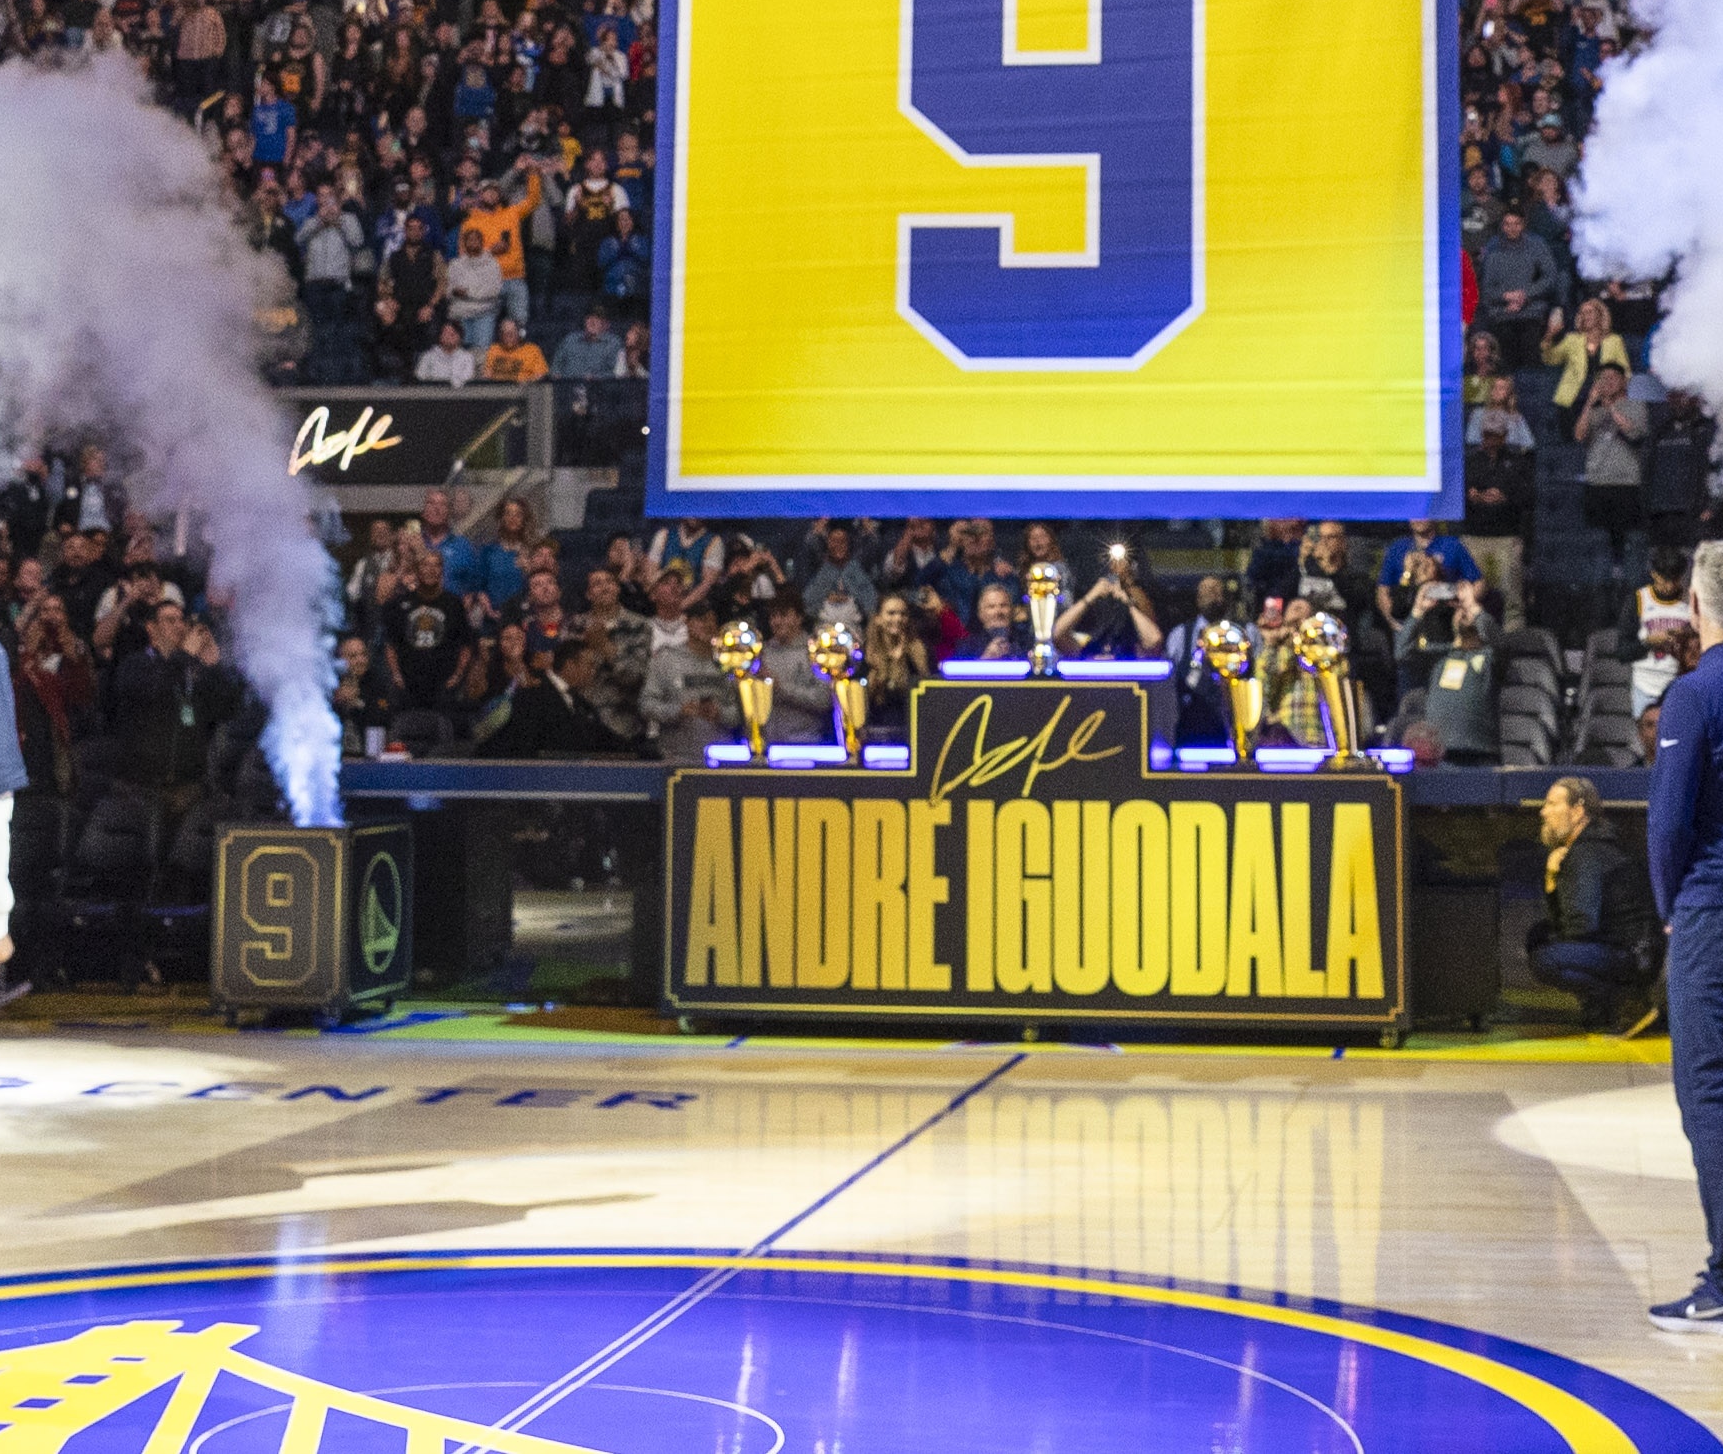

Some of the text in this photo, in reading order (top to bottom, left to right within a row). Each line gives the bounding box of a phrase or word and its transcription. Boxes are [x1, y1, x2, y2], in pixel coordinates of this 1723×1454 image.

[240, 845, 320, 987] 9
[684, 796, 1385, 999] ANDRE IGUODALA
[80, 1081, 696, 1111] CENTER
